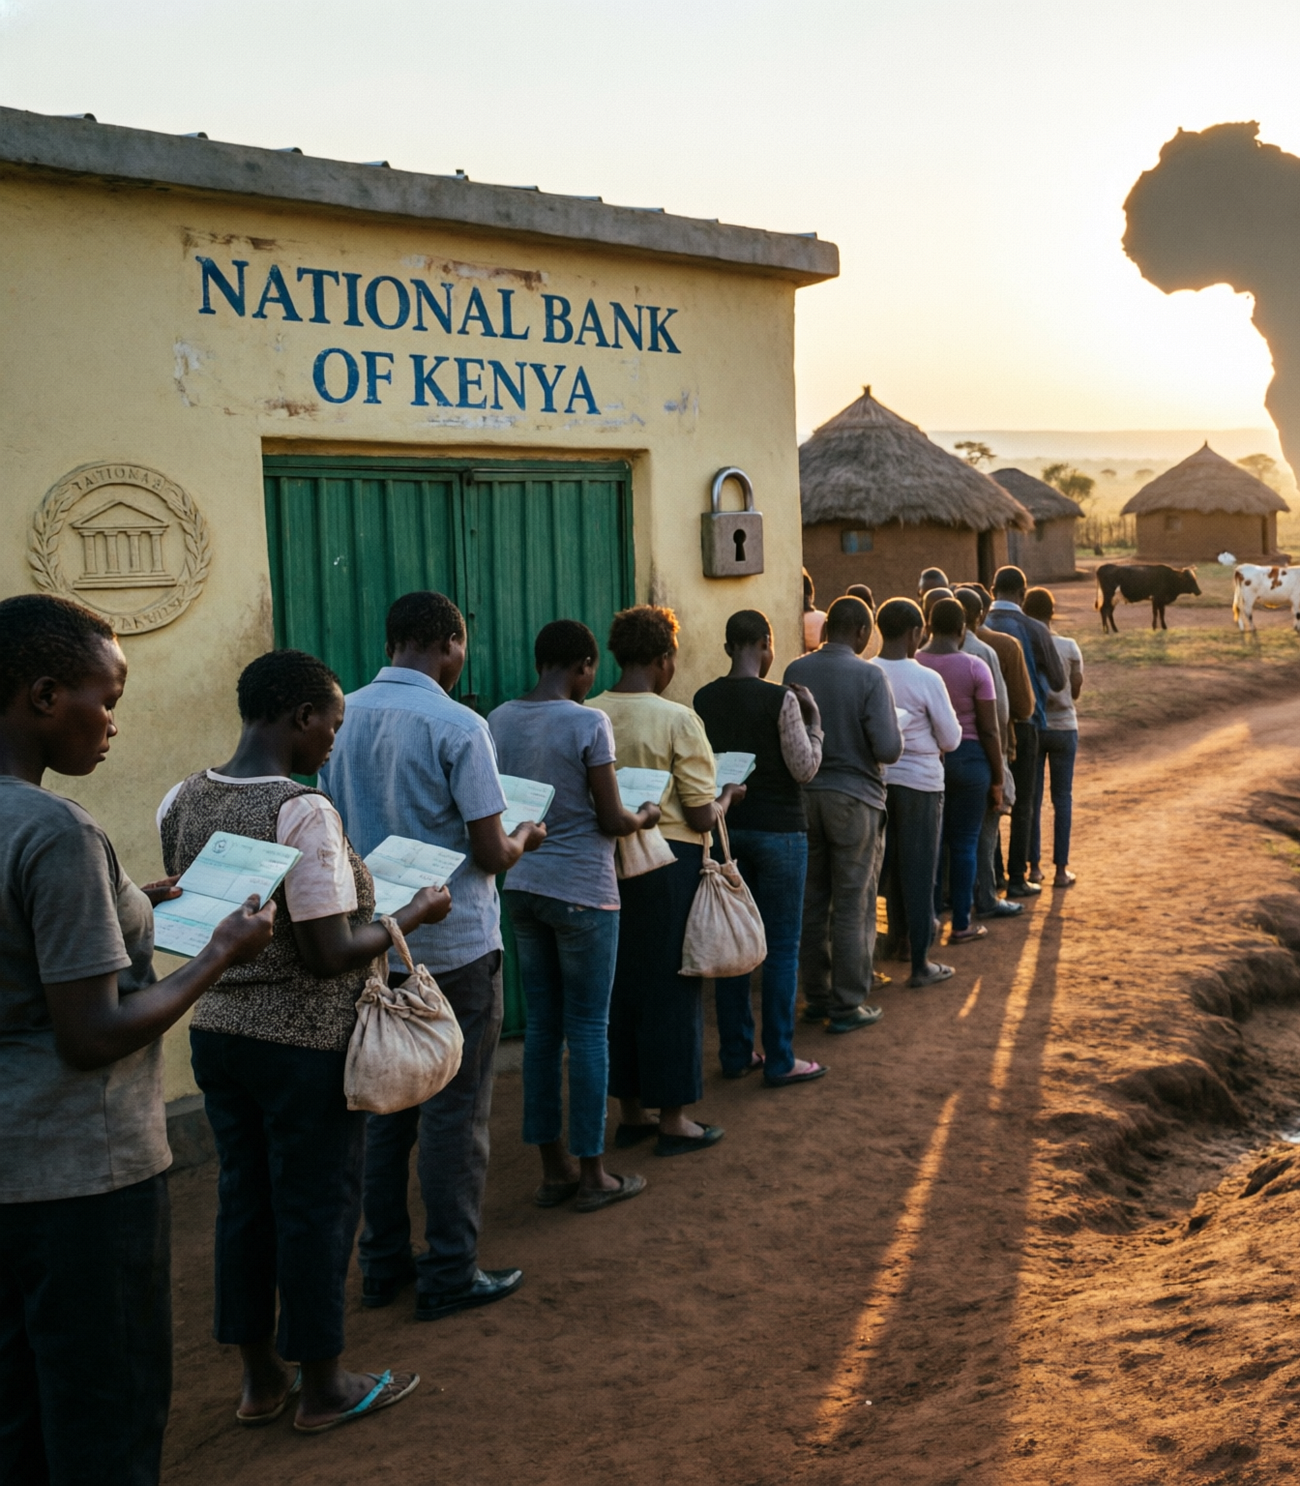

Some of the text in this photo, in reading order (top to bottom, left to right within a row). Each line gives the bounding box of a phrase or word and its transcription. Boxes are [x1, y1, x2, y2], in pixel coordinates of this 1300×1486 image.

[195, 255, 682, 354] NATIONAL BANK
[312, 347, 602, 415] OF KENYA
